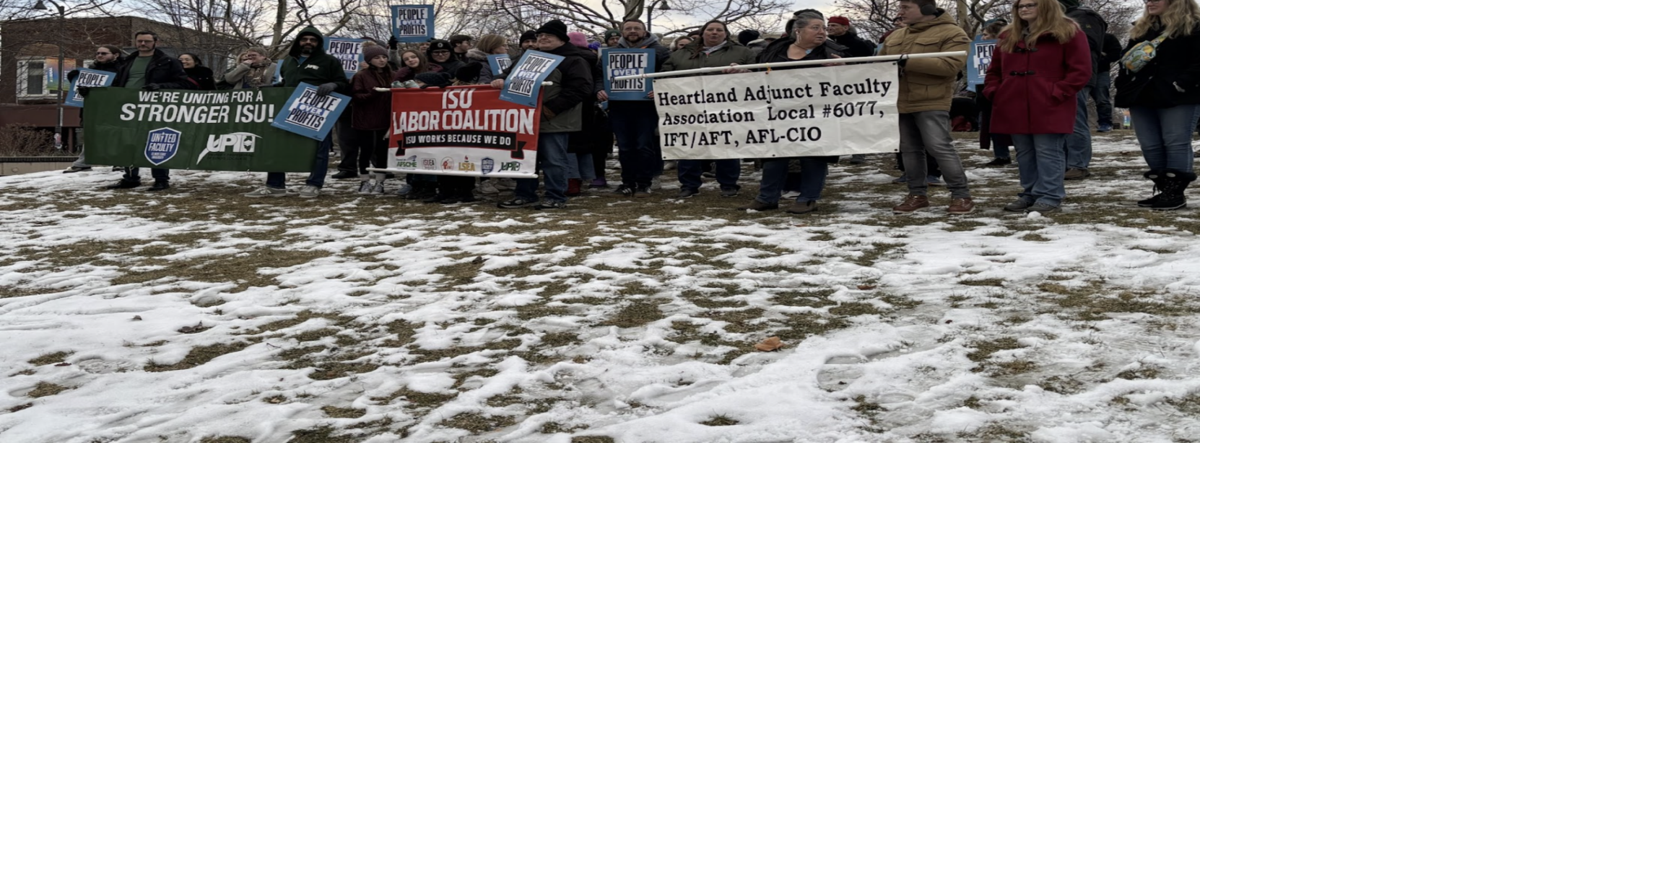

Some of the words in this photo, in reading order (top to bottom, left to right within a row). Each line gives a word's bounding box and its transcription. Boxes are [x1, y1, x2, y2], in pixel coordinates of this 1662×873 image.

[398, 8, 425, 20] PEOPLE
[399, 25, 425, 35] PROFITS
[330, 41, 360, 54] PEOPLE
[977, 44, 995, 58] PEO
[341, 59, 357, 70] FITS
[520, 56, 552, 72] PEOPLE
[609, 54, 644, 69] PEOPLE
[78, 72, 105, 86] PEOPLE
[509, 76, 534, 93] PROFITS
[610, 76, 643, 89] PROFITS
[138, 91, 180, 103] WE'RE
[182, 92, 229, 104] UNITING
[231, 91, 253, 102] FOR
[255, 91, 264, 102] A
[442, 88, 475, 109] ISU
[658, 89, 738, 106] Heartland
[744, 83, 813, 104] Adjunct
[819, 78, 892, 97] Faculty
[299, 90, 337, 111] PEOPLE
[120, 103, 230, 123] STRONGER
[235, 104, 275, 123] ISU!
[299, 104, 323, 115] OVER
[662, 109, 755, 126] Association
[767, 103, 815, 121] Local
[822, 100, 884, 118] #6077,
[287, 108, 324, 128] PROFITS
[392, 110, 440, 135] LABOR
[442, 109, 535, 135] COALITION
[150, 132, 177, 143] UNITED
[405, 136, 416, 145] ISU
[418, 135, 446, 144] WORKS
[447, 134, 482, 144] BECAUSE
[484, 135, 497, 144] WE
[499, 136, 511, 146] DO
[664, 130, 739, 149] IFT/AFT,
[745, 126, 822, 144] AFL-CIO
[148, 143, 174, 152] FACULTY
